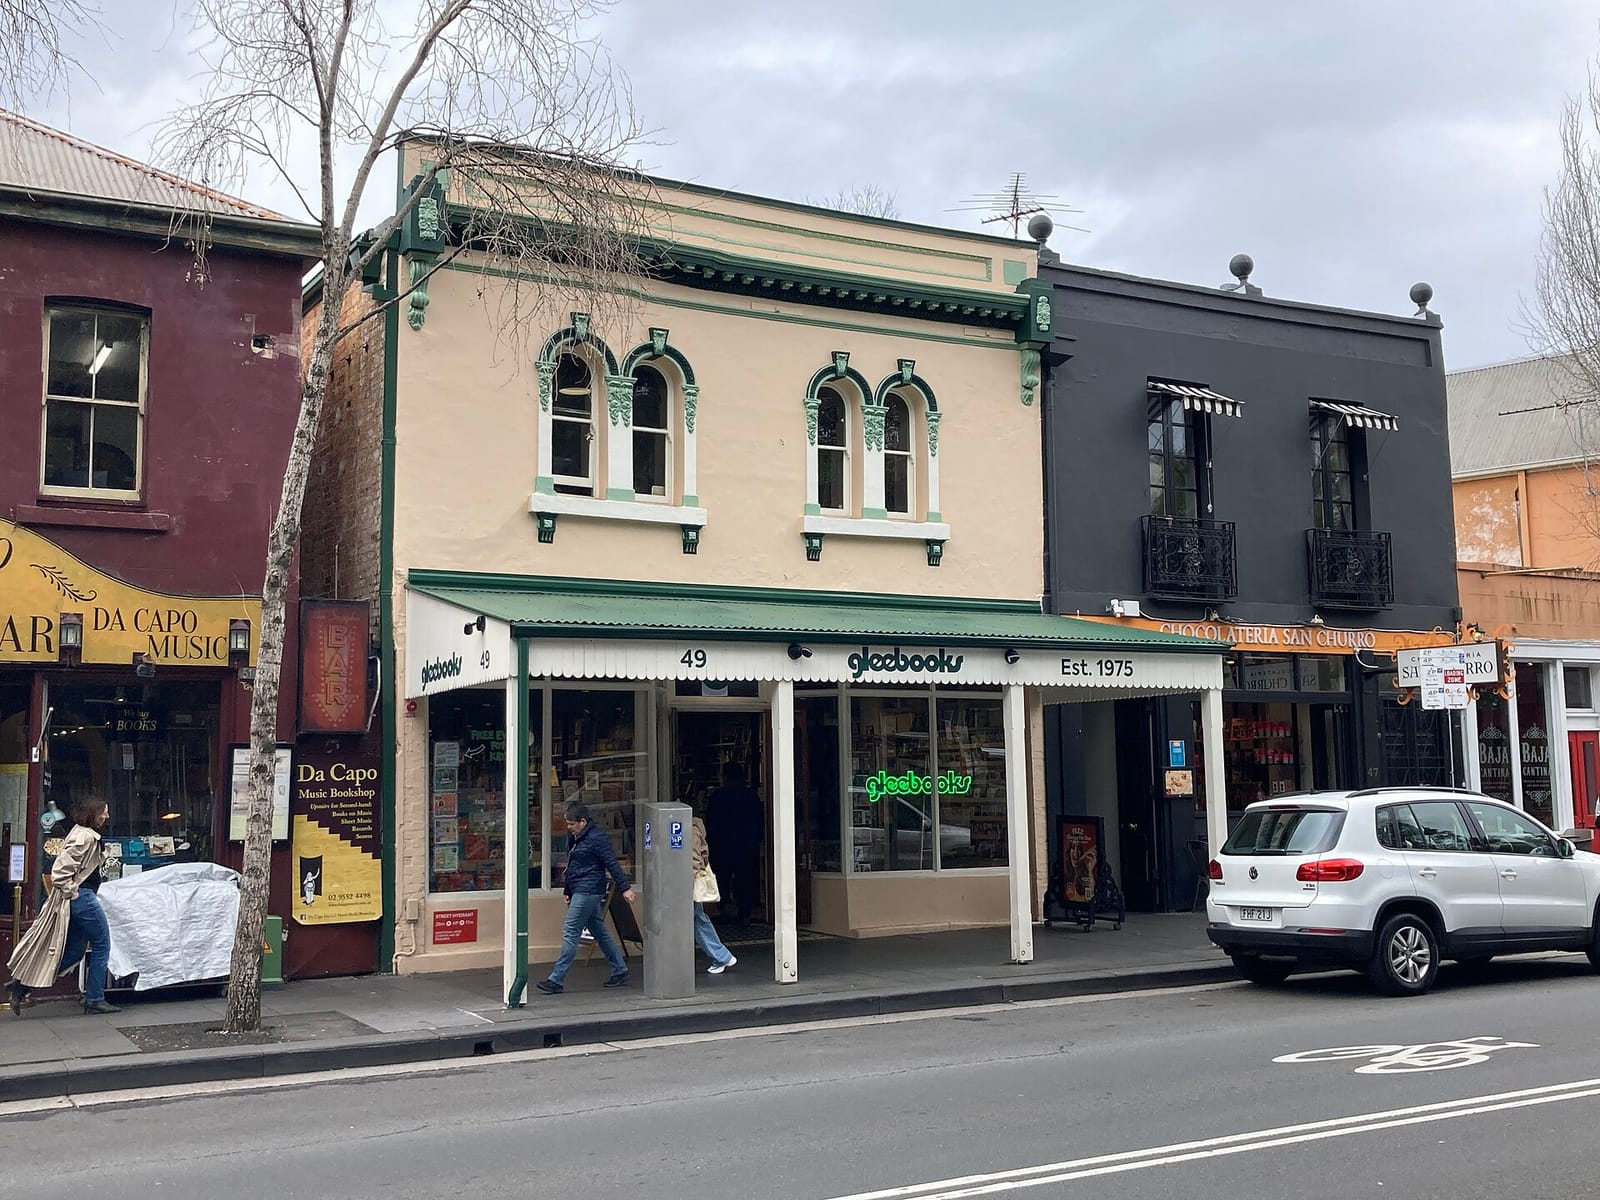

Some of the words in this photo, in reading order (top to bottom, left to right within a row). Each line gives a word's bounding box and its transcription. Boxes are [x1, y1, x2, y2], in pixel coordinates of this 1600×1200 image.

[93, 607, 126, 631] DA
[134, 608, 198, 633] CAPO
[148, 635, 227, 660] MUSIC
[1283, 628, 1312, 646] SAN
[1317, 630, 1376, 648] CHURRO
[323, 624, 348, 705] BAR
[480, 650, 490, 669] 49
[680, 649, 707, 668] 49
[848, 647, 964, 678] gleebooks
[1061, 658, 1092, 676] Est.
[1096, 659, 1133, 676] 1975
[422, 651, 462, 691] gleebooks
[1403, 666, 1419, 679] SA
[117, 720, 157, 731] BOOKS
[1480, 743, 1509, 764] BAJA
[297, 764, 325, 782] Da
[330, 763, 378, 786] Capo
[298, 789, 327, 799] Music
[330, 787, 376, 799] Bookshop
[866, 770, 972, 802] gleebooks
[672, 823, 681, 834] P
